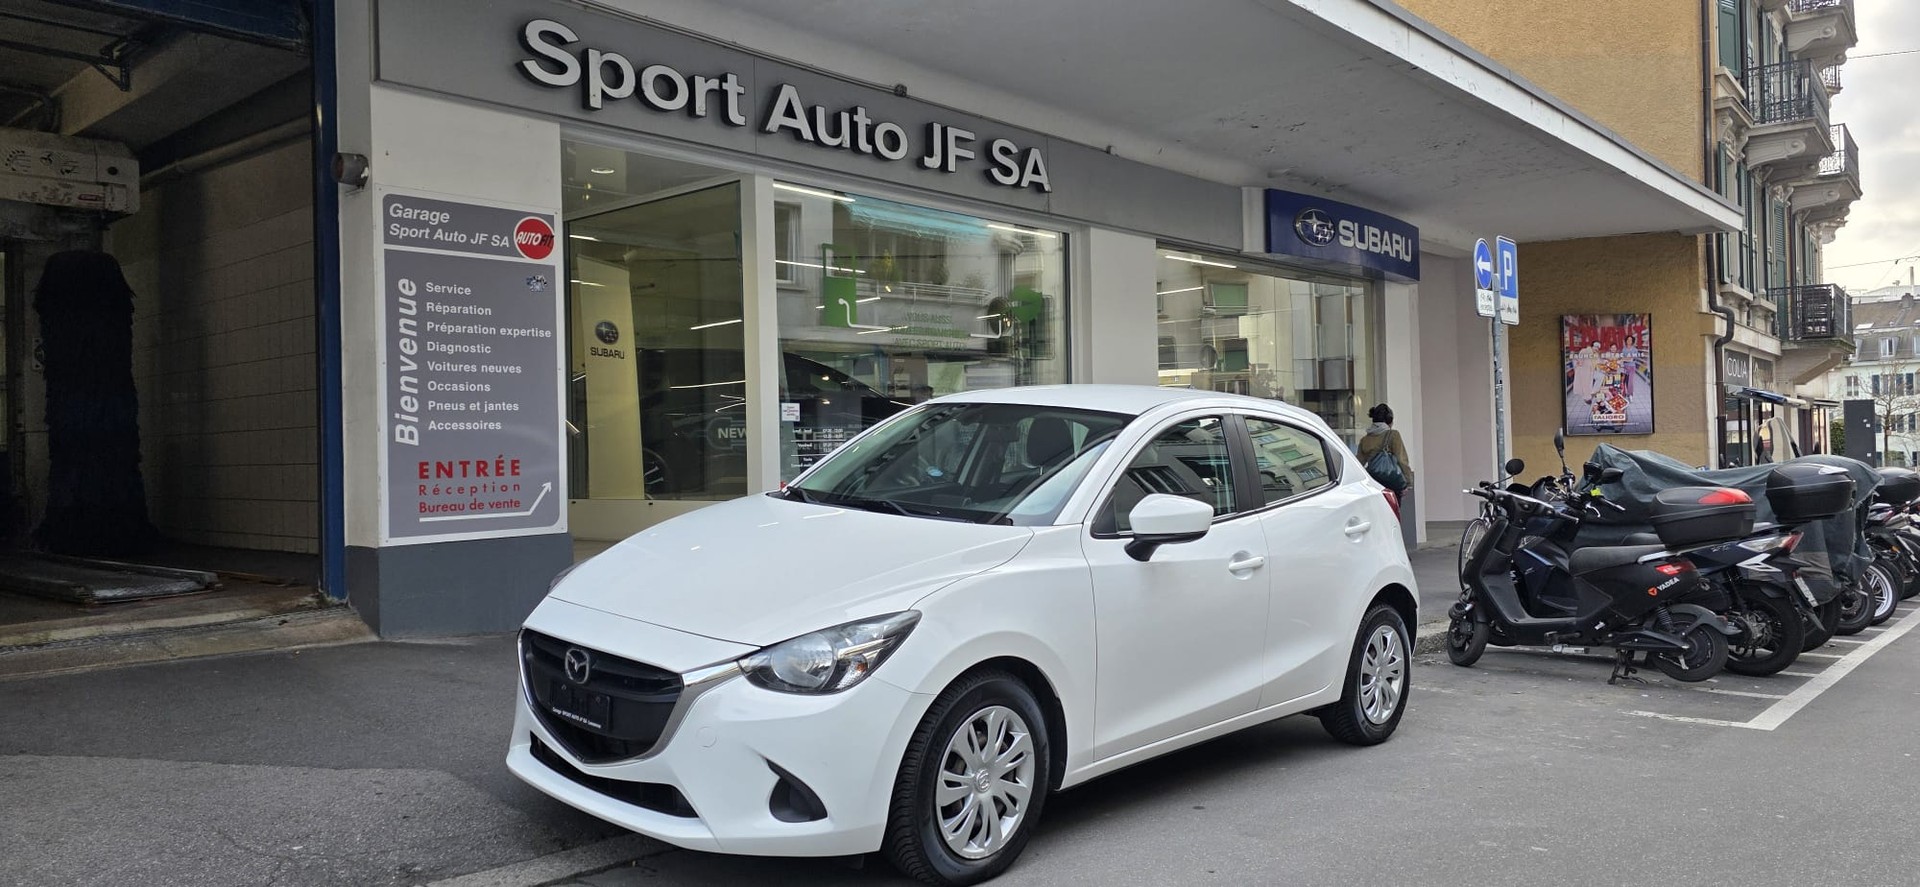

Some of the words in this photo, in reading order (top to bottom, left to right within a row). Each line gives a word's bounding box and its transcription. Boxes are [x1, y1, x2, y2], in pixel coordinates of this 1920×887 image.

[521, 18, 746, 127] Sport
[764, 83, 909, 161] Auto
[920, 122, 975, 173] JF
[988, 137, 1052, 193] SA
[389, 203, 450, 225] Garage
[389, 223, 430, 239] Sport
[433, 228, 467, 243] Auto
[470, 233, 488, 245] JF
[491, 234, 510, 247] SA
[1338, 220, 1412, 262] SUBARU
[1503, 250, 1512, 290] P
[426, 281, 472, 295] Service
[426, 301, 492, 316] Réparation
[427, 321, 496, 335] Préparation
[500, 326, 552, 338] expertise
[427, 341, 491, 355] Diagnostic
[591, 346, 625, 359] SUBARU
[395, 278, 419, 446] Bienvenue
[427, 361, 477, 373] Voitures
[481, 363, 522, 374] neuves
[427, 381, 491, 392] Occasions
[428, 401, 465, 411] Pneus
[469, 401, 480, 411] et
[484, 401, 519, 413] jantes
[428, 420, 501, 431] Accessoires
[418, 455, 520, 480] ENTRÉE
[419, 481, 520, 497] Réception
[419, 501, 465, 513] Bureau
[469, 498, 484, 511] de
[488, 498, 521, 509] vente
[1657, 577, 1680, 591] YADEA
